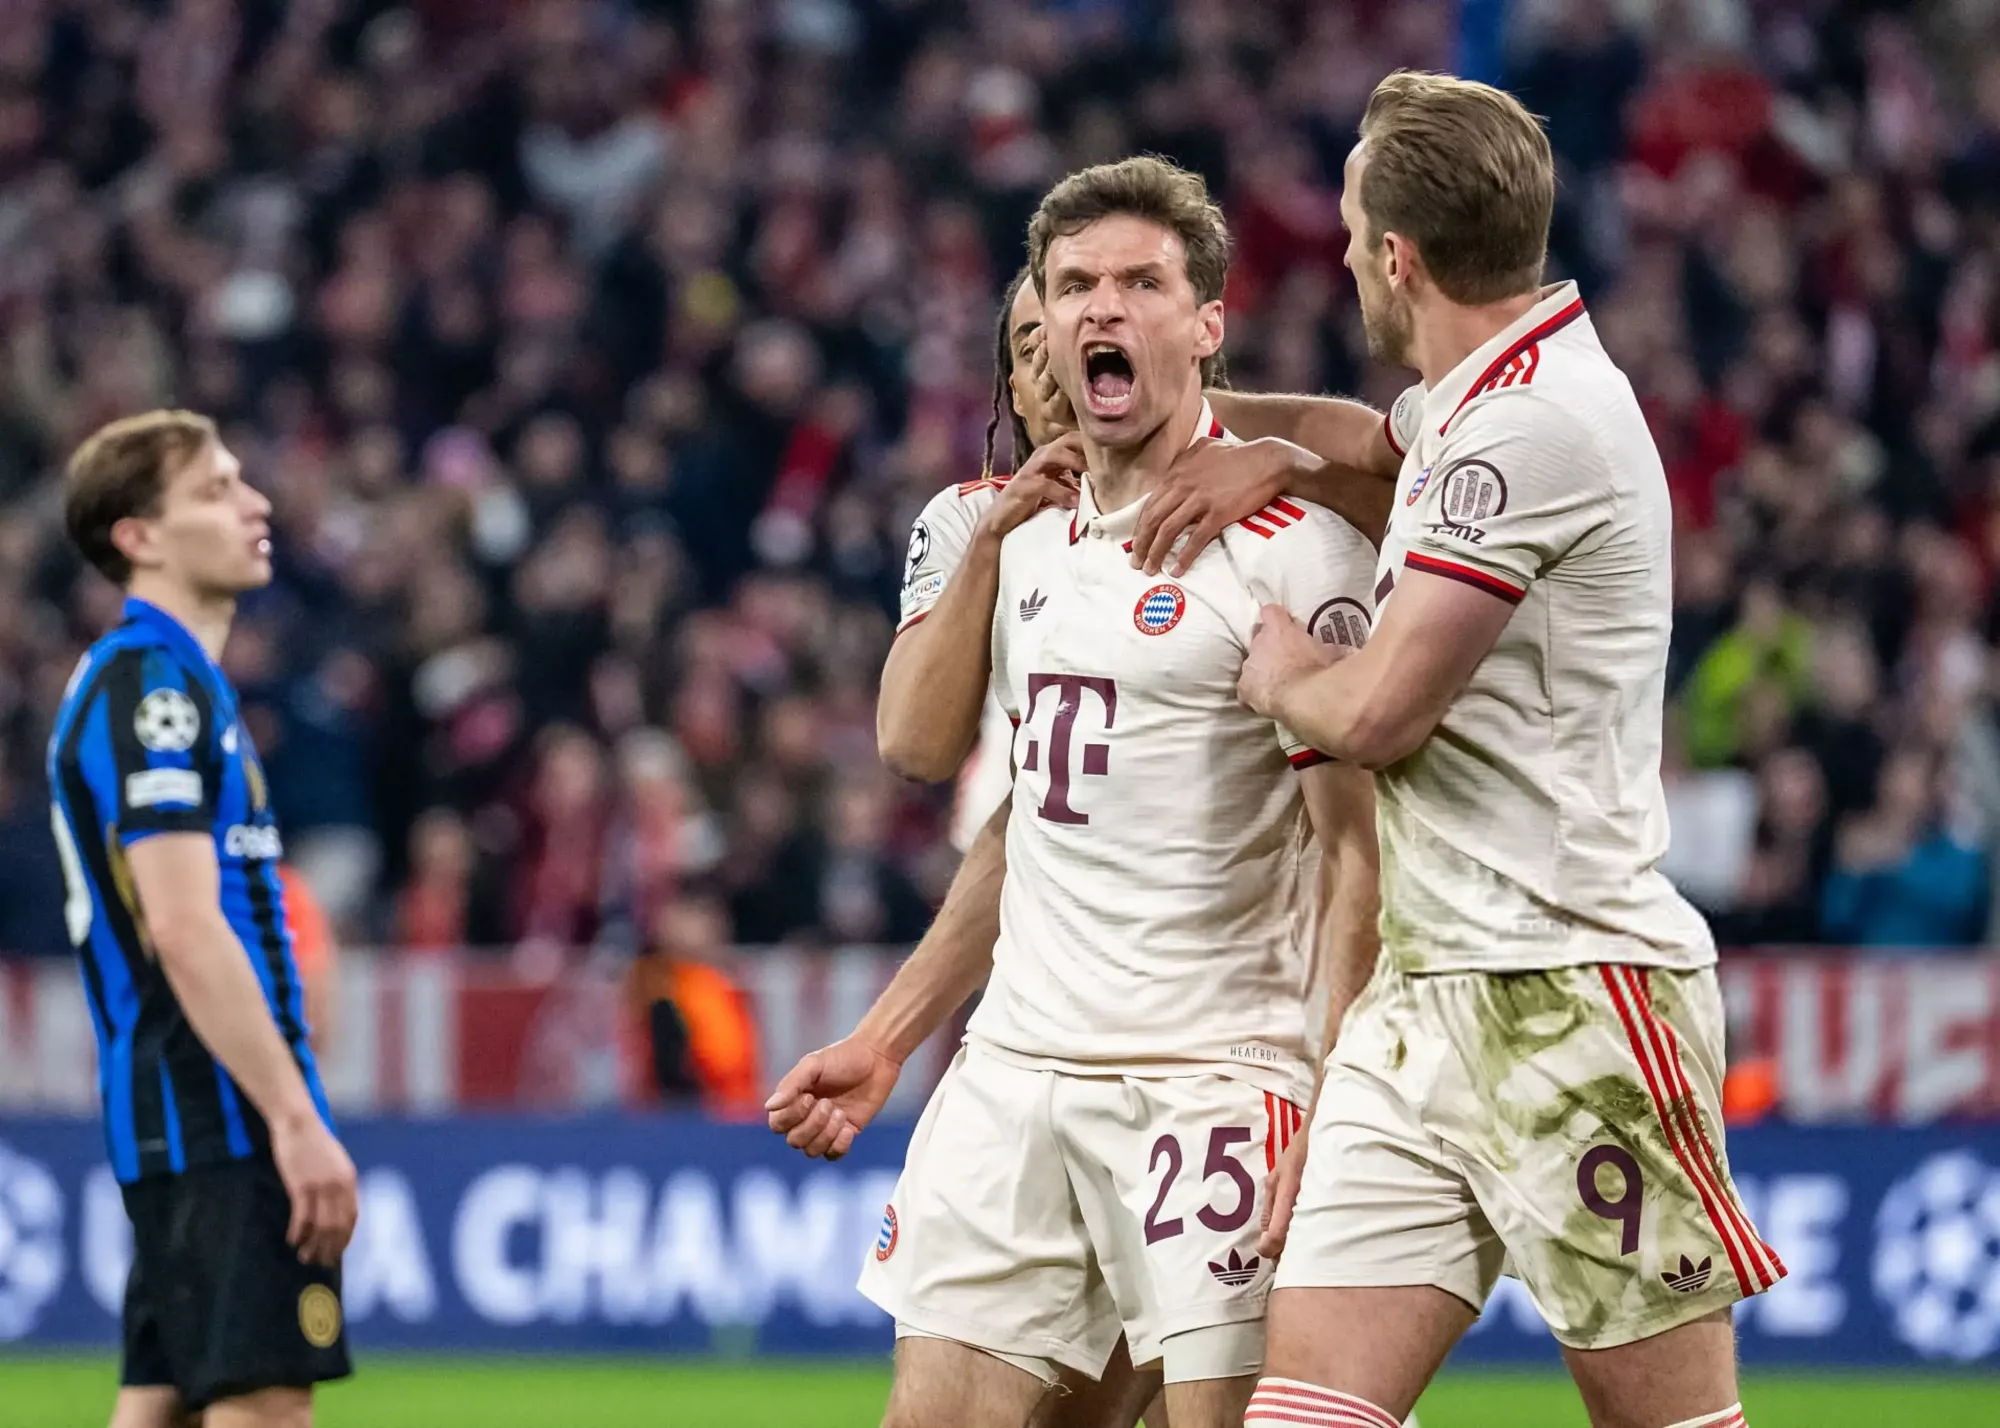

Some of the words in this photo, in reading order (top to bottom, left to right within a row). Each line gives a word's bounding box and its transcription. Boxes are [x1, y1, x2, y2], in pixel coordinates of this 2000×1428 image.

[1159, 585, 1184, 604] BAYERN
[1023, 672, 1118, 825] T
[1144, 1126, 1256, 1247] 25
[1576, 1143, 1644, 1257] 9
